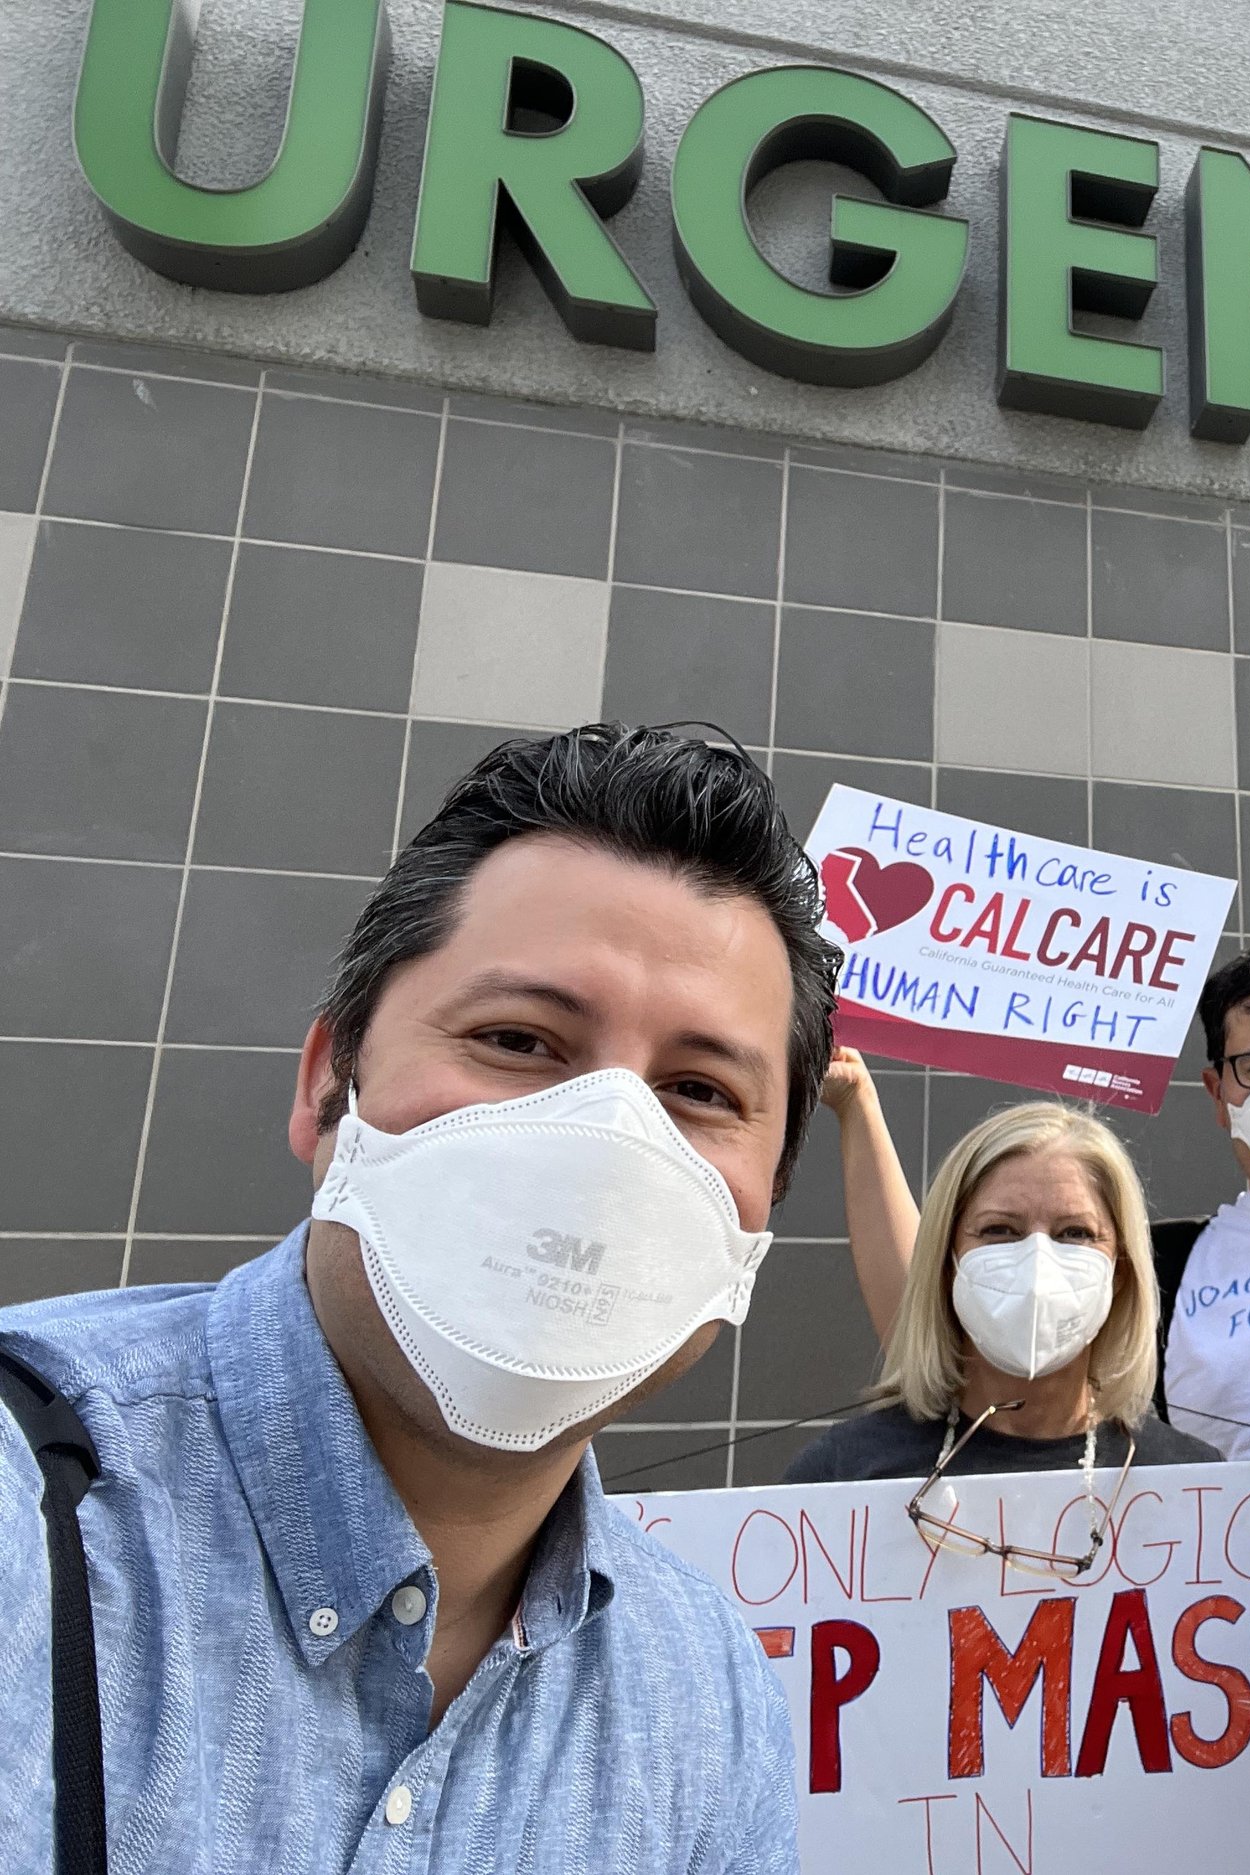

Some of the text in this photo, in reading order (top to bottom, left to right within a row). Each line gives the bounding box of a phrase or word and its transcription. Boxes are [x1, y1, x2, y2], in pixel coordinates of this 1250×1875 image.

[1141, 870, 1178, 908] is
[929, 883, 1196, 991] CALCARE
[841, 953, 1157, 1048] HUMAN RIGHT
[919, 946, 1176, 1010] California Guaranteed Health Care for All
[526, 1227, 607, 1276] 3M
[526, 1287, 590, 1318] NIOSH
[732, 1500, 960, 1605] ONLY
